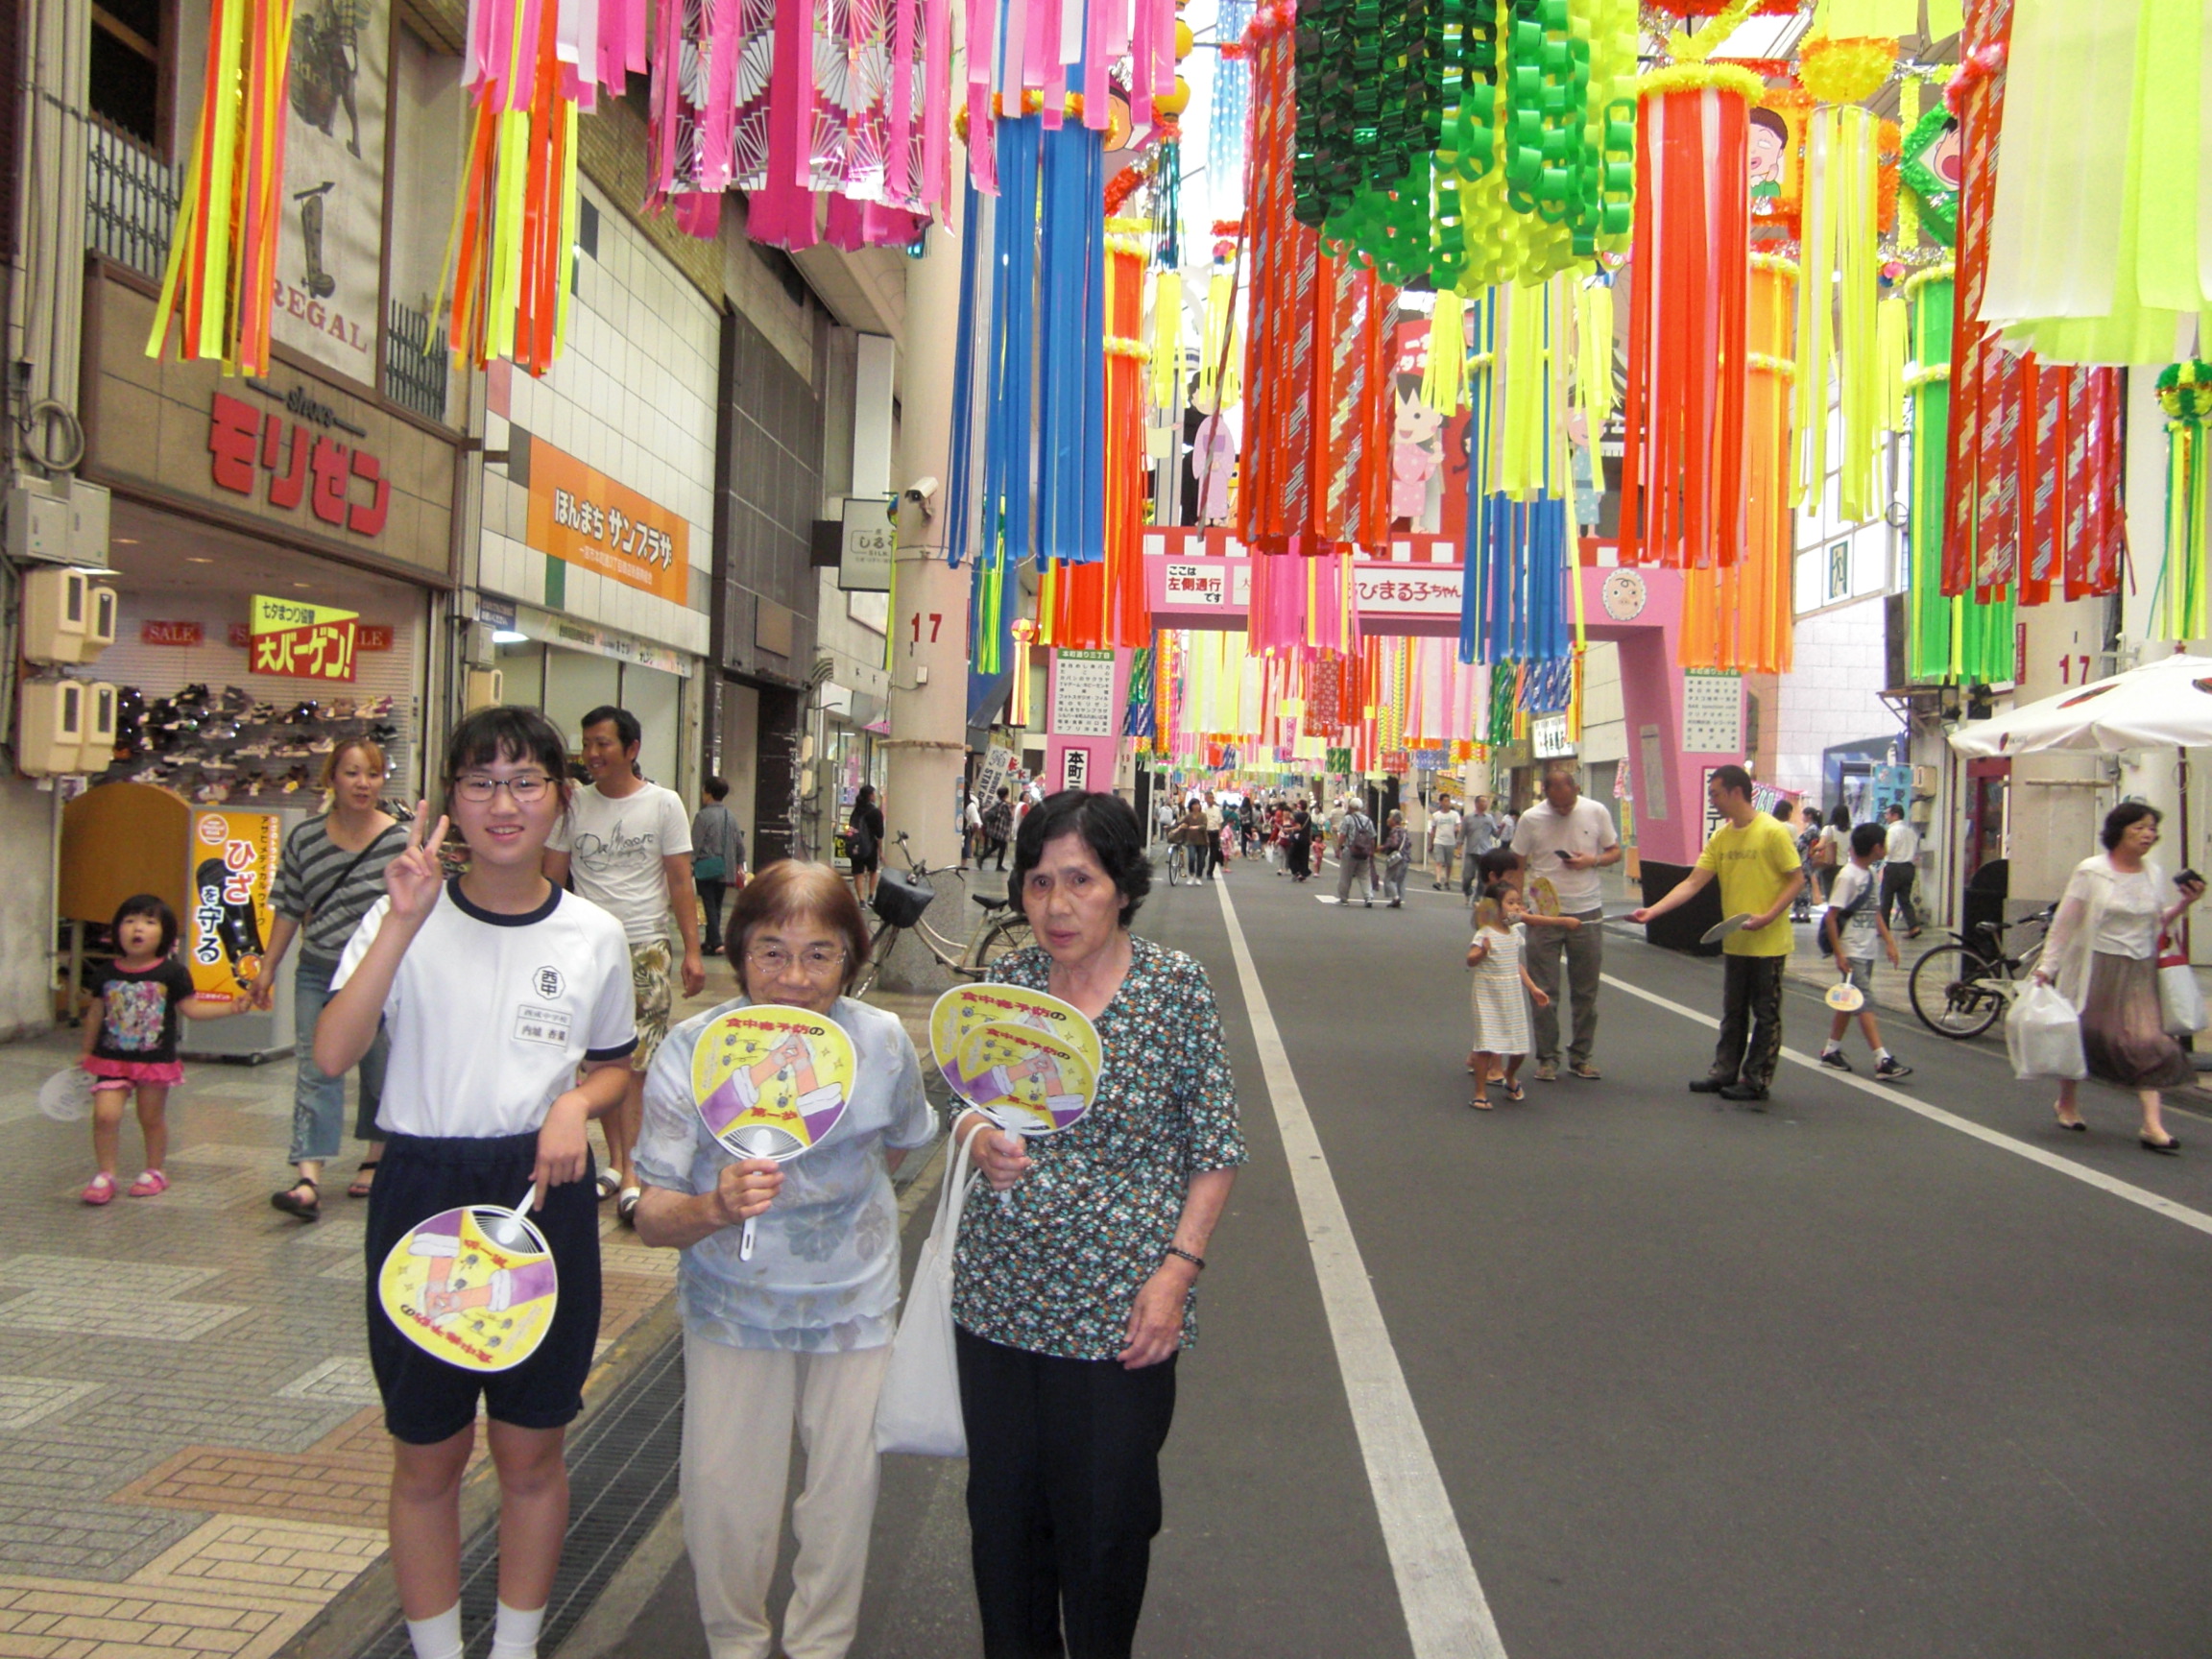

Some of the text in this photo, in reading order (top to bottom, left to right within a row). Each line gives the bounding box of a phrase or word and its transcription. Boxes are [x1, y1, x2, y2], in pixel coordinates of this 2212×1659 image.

[207, 391, 391, 537] モリゼン
[554, 487, 673, 572] ほんまち サンプラザ
[1167, 577, 1221, 591] 左側通行
[1168, 565, 1197, 576] ここは
[1204, 592, 1221, 603] です
[150, 624, 194, 642] SALE
[911, 612, 942, 643] 17
[257, 622, 355, 679] 大バーゲン!
[2058, 654, 2090, 685] 17
[223, 840, 258, 904] ひざ
[197, 885, 224, 964] を守る
[961, 991, 1068, 1022] 食中毒予防の
[725, 1017, 826, 1037] 食中毒予防の
[750, 1106, 798, 1121] 第一歩
